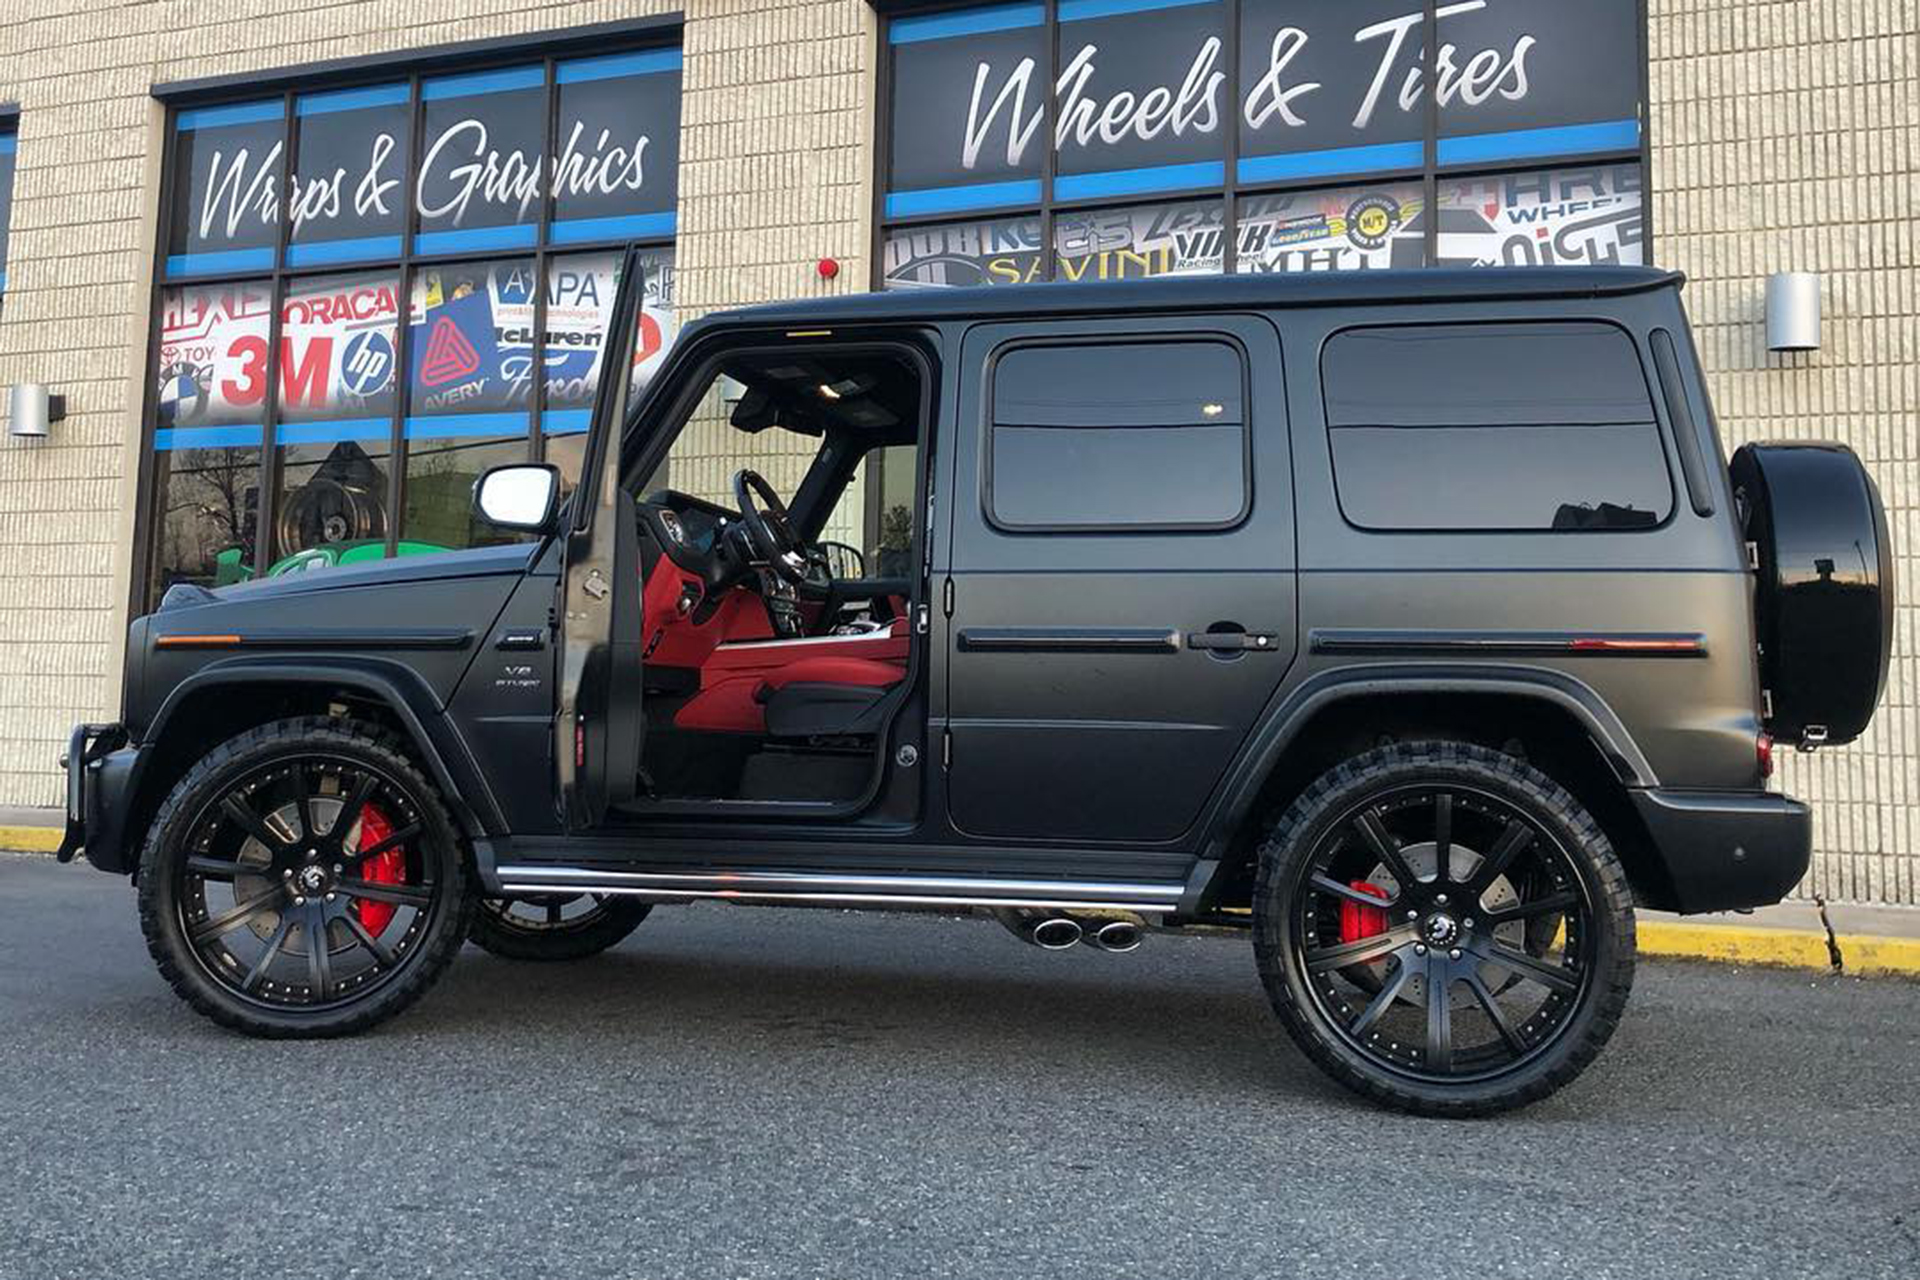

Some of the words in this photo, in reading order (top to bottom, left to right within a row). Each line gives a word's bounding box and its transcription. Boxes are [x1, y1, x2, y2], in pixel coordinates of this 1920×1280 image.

[962, 36, 1226, 169] Wheels
[1244, 27, 1322, 129] &
[1352, 0, 1537, 128] Tires
[200, 139, 345, 239] Wraps
[354, 133, 399, 216] &
[416, 119, 650, 229] Graphics
[1178, 257, 1221, 268] Racing
[281, 283, 417, 324] ORACAL
[347, 330, 389, 393] hp
[496, 328, 602, 347] cLren
[221, 335, 333, 408] 3M
[425, 379, 486, 407] AVERY
[500, 351, 593, 399] Frd
